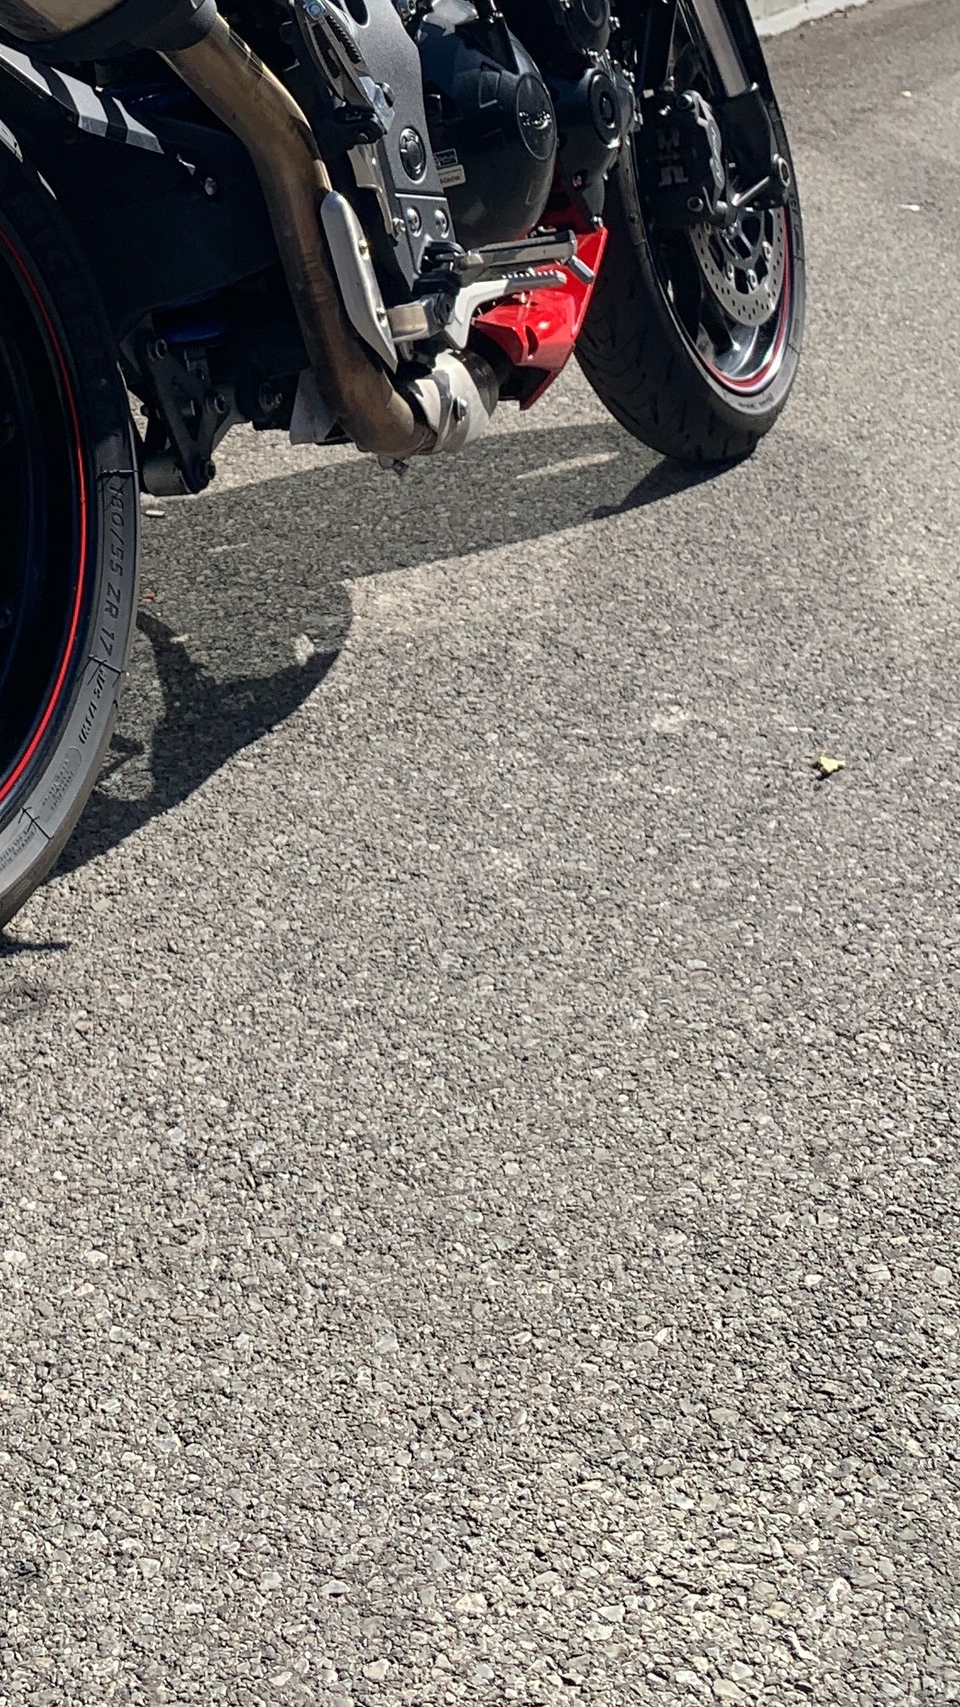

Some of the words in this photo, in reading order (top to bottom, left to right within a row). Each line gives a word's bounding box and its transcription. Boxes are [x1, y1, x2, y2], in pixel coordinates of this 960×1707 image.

[109, 486, 125, 576] 180/55
[104, 582, 121, 619] ZR
[100, 627, 115, 656] 17
